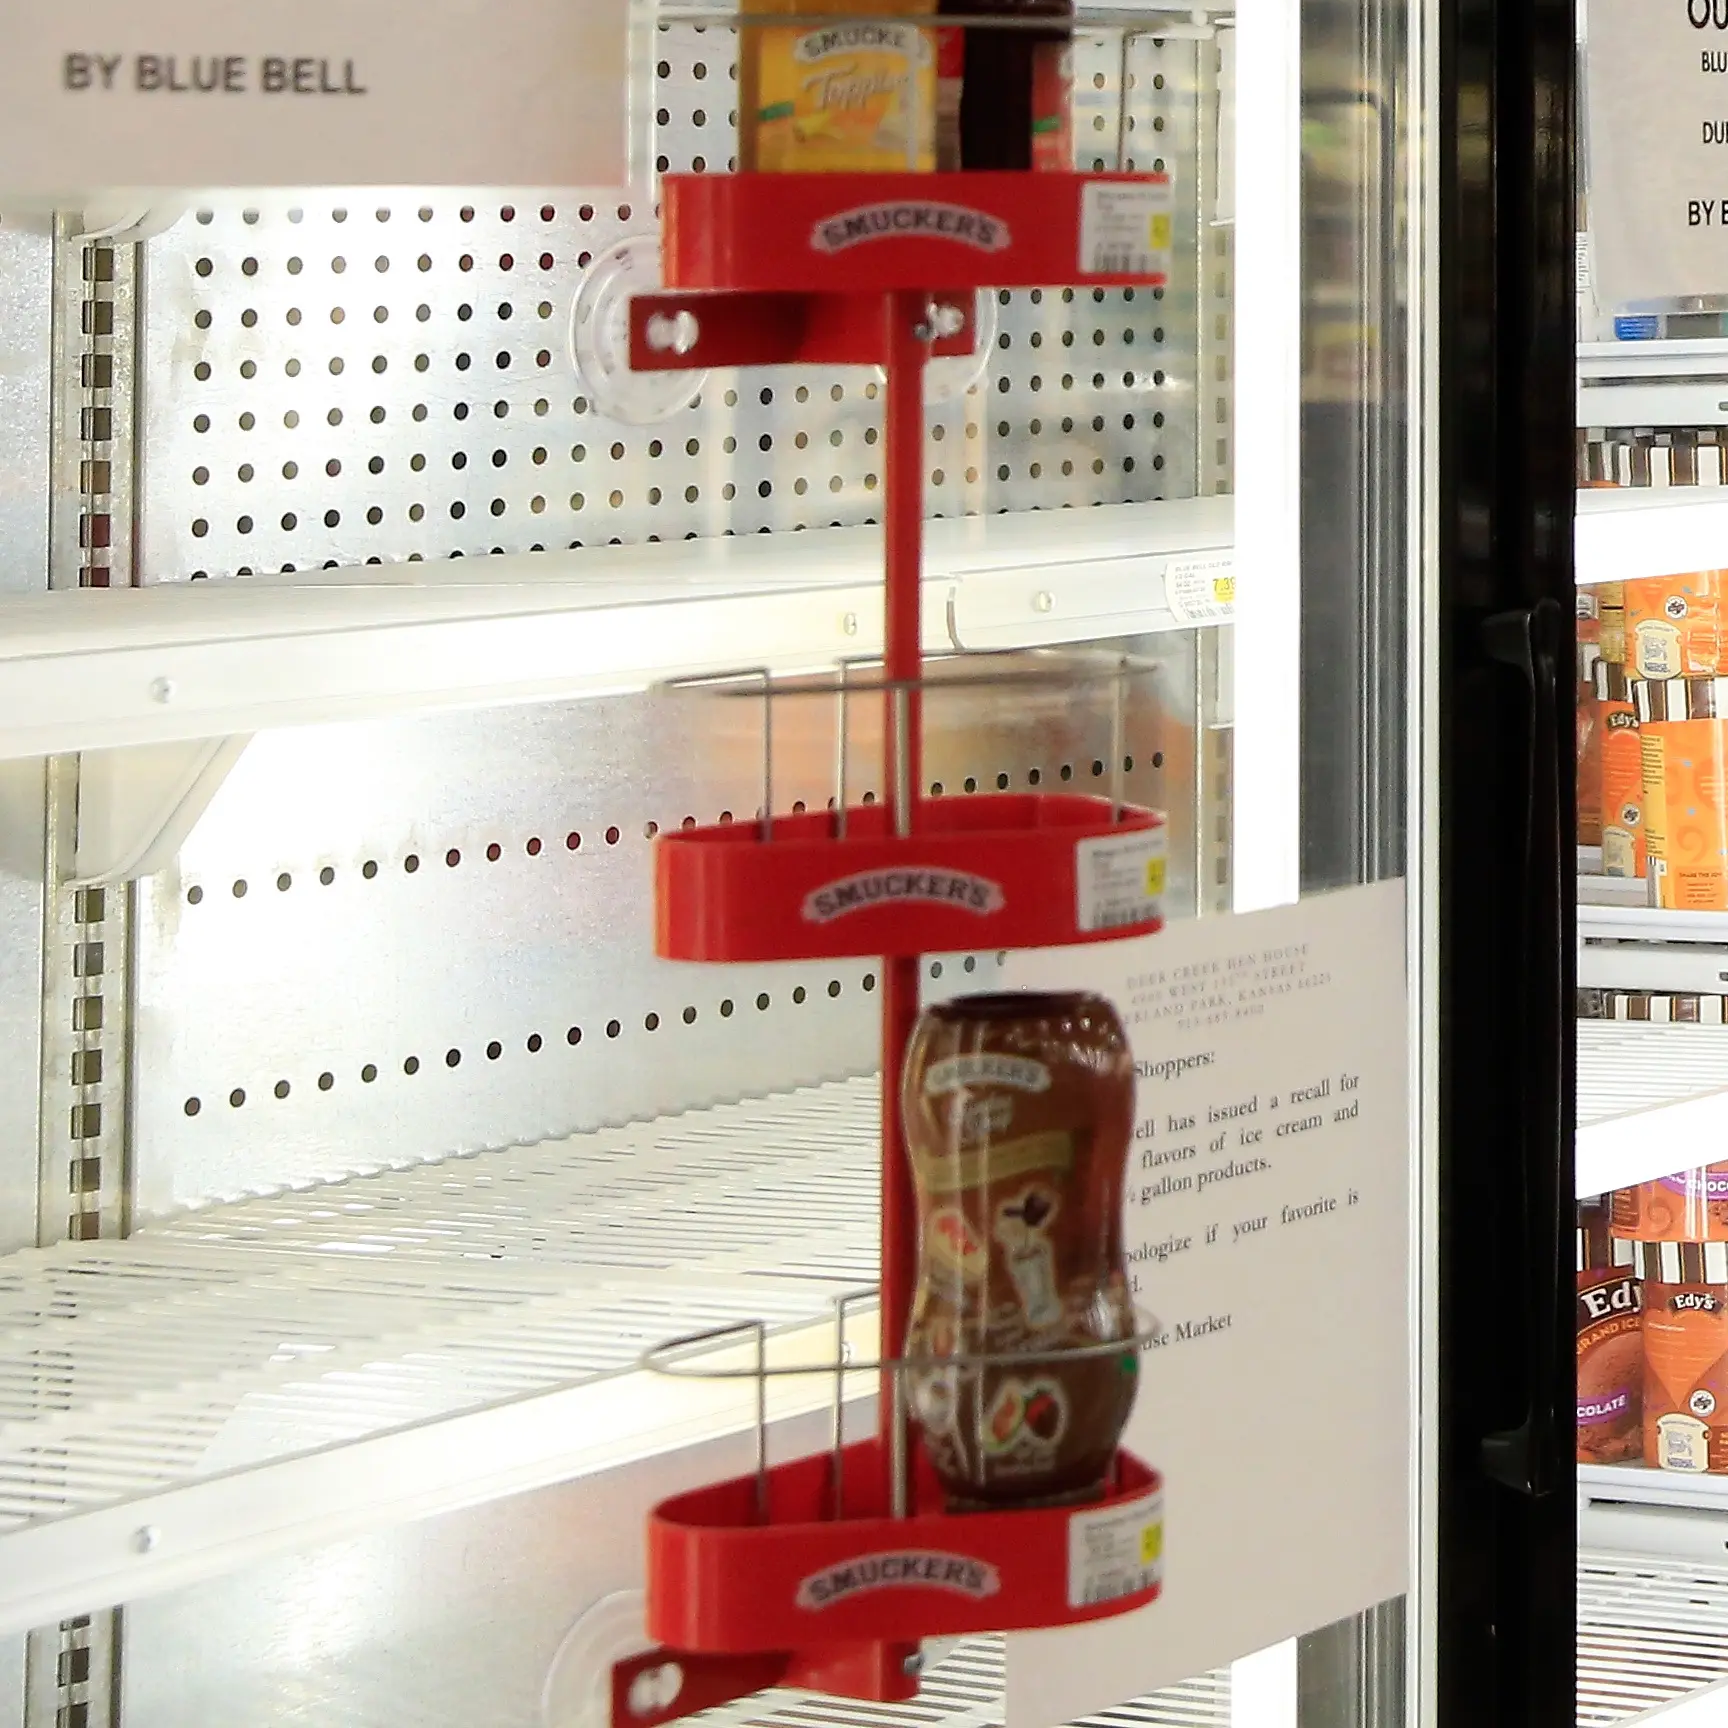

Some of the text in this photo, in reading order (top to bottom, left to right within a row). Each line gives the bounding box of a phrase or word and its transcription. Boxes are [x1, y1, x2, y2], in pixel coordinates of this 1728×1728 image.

[62, 52, 368, 95] BY BLUE BELL
[1688, 201, 1715, 226] BY
[1134, 1050, 1215, 1081] Shoppers:
[1135, 1072, 1359, 1140] ell has issued a recall for
[1141, 1099, 1359, 1169] flavors of ice cream and
[1140, 1155, 1272, 1206] gallon products.
[1206, 1222, 1219, 1244] if
[1232, 1215, 1269, 1243] your
[1281, 1195, 1338, 1225] favorite
[1347, 1187, 1360, 1205] is
[1673, 1293, 1716, 1311] Edy's
[1174, 1313, 1233, 1343] Market
[1577, 1394, 1628, 1418] COLATE
